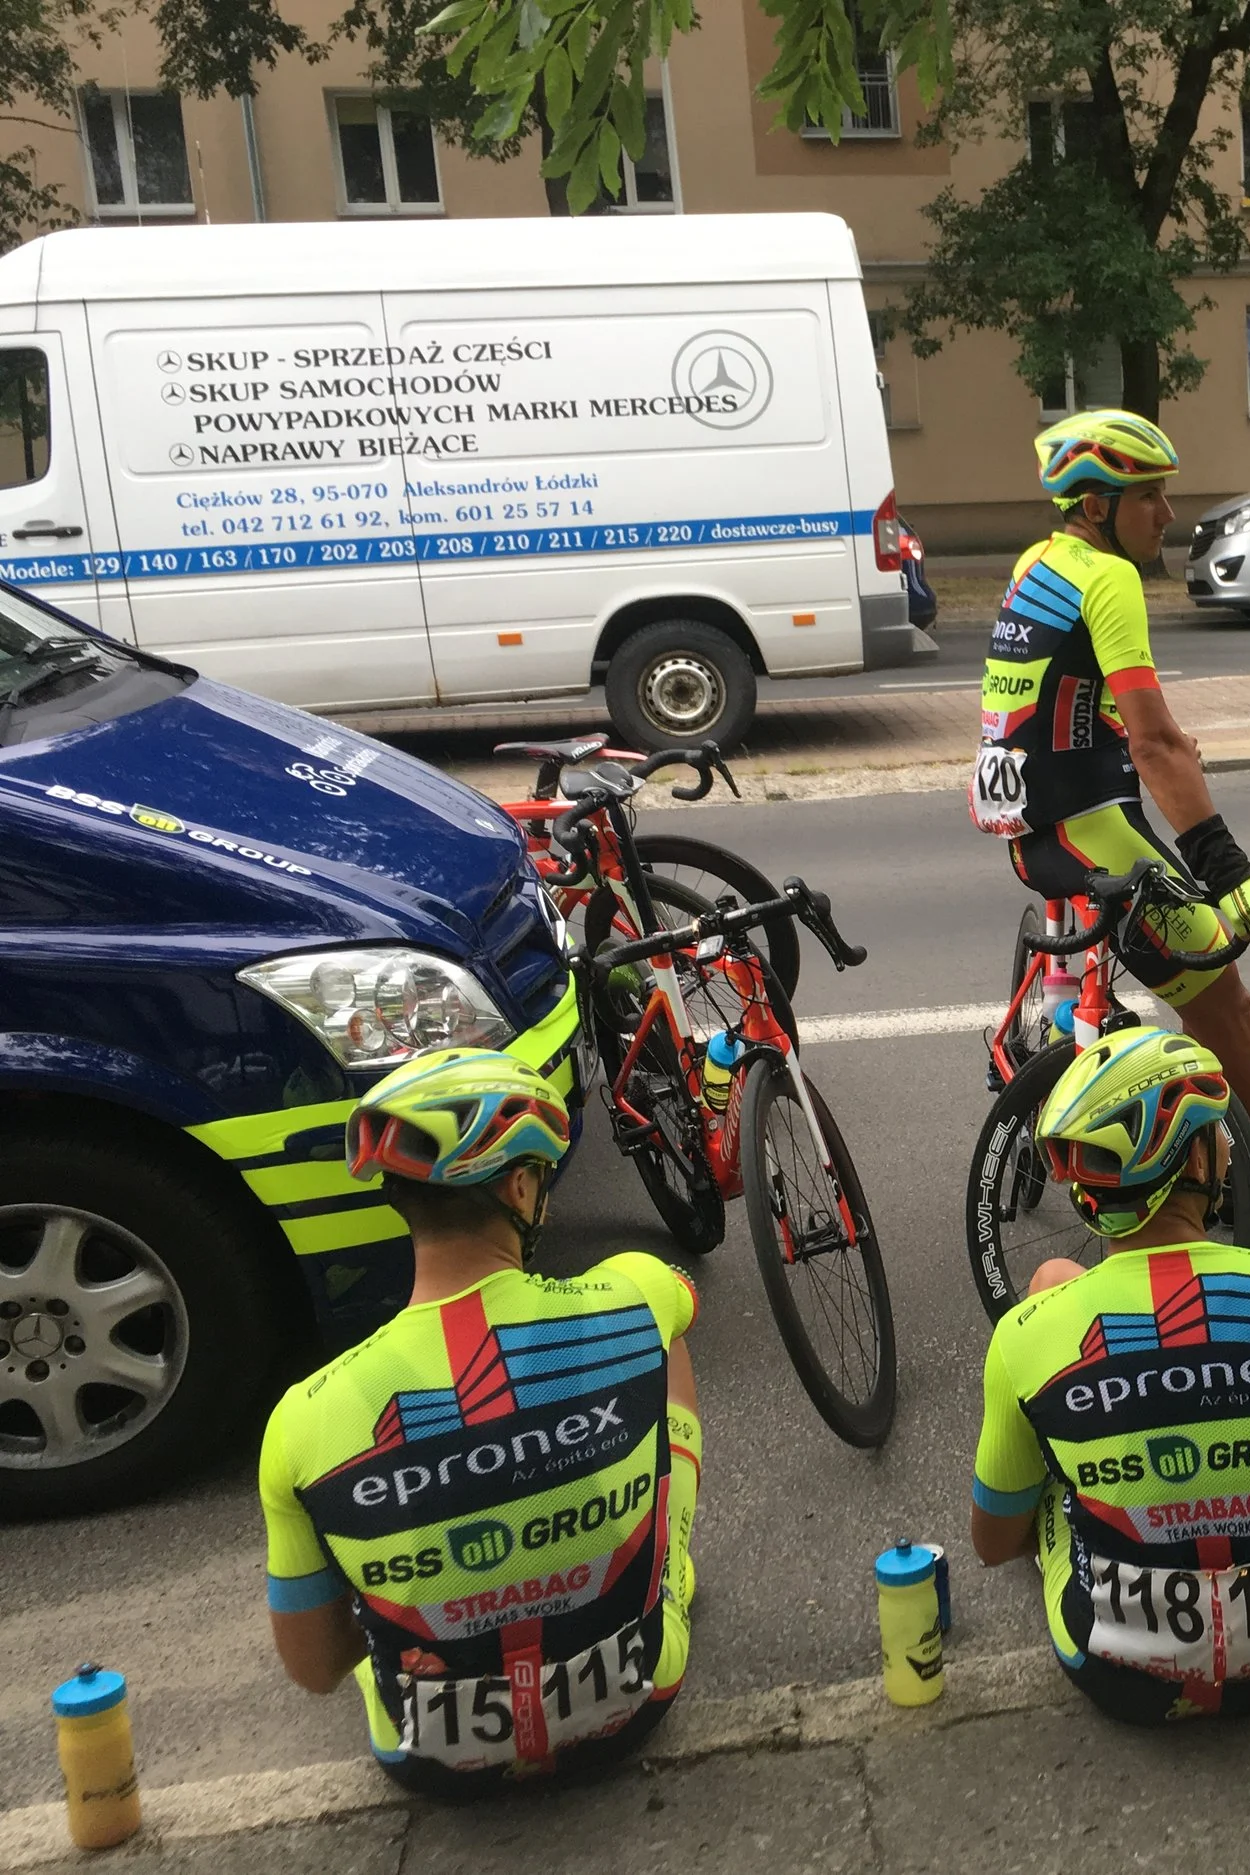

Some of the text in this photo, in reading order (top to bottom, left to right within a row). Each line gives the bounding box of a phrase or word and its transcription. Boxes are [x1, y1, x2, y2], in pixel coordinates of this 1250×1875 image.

[187, 350, 269, 372] SKUP
[293, 340, 445, 368] SPRZEDAŻ
[453, 336, 552, 366] CZĘŚCI
[189, 366, 502, 404] SKUP SAMOCHODÓW
[194, 394, 739, 434] POWYPADKOWYCH MARKI MERCEDES
[199, 432, 479, 465] NAPRAWY BIEŻĄCE
[176, 473, 599, 511] Ciężków 28, 95-070 Aleksandrów Łódzki
[182, 500, 595, 537] tel. 042 712 61 92, kom. 601 25 57 14
[0, 562, 75, 581] Modele:
[83, 557, 120, 576] 129
[140, 553, 178, 572] 140
[200, 550, 238, 569] 163
[260, 546, 297, 566] 170
[320, 543, 358, 562] 202
[379, 540, 416, 558] 203
[437, 537, 474, 555] 208
[494, 533, 530, 552] 210
[548, 530, 584, 549] 211
[604, 527, 640, 546] 215
[657, 525, 692, 543] 220
[711, 517, 840, 540] dostawcze-busy
[1073, 679, 1097, 749] SOUDAL
[45, 784, 126, 815] BSS
[187, 829, 313, 876] GROUP
[1127, 1066, 1181, 1097] FORCE
[1200, 1392, 1223, 1407] Az
[352, 1397, 625, 1506] epronex
[511, 1429, 630, 1485] Az építő erő
[1077, 1454, 1145, 1488] BSS
[362, 1547, 445, 1588] BSS
[521, 1472, 652, 1550] GROUP
[1165, 1523, 1211, 1541] TEAMS
[444, 1566, 591, 1626] STRABAG
[1101, 1560, 1205, 1644] 118
[464, 1610, 522, 1636] TEAMS
[543, 1621, 647, 1721] 115
